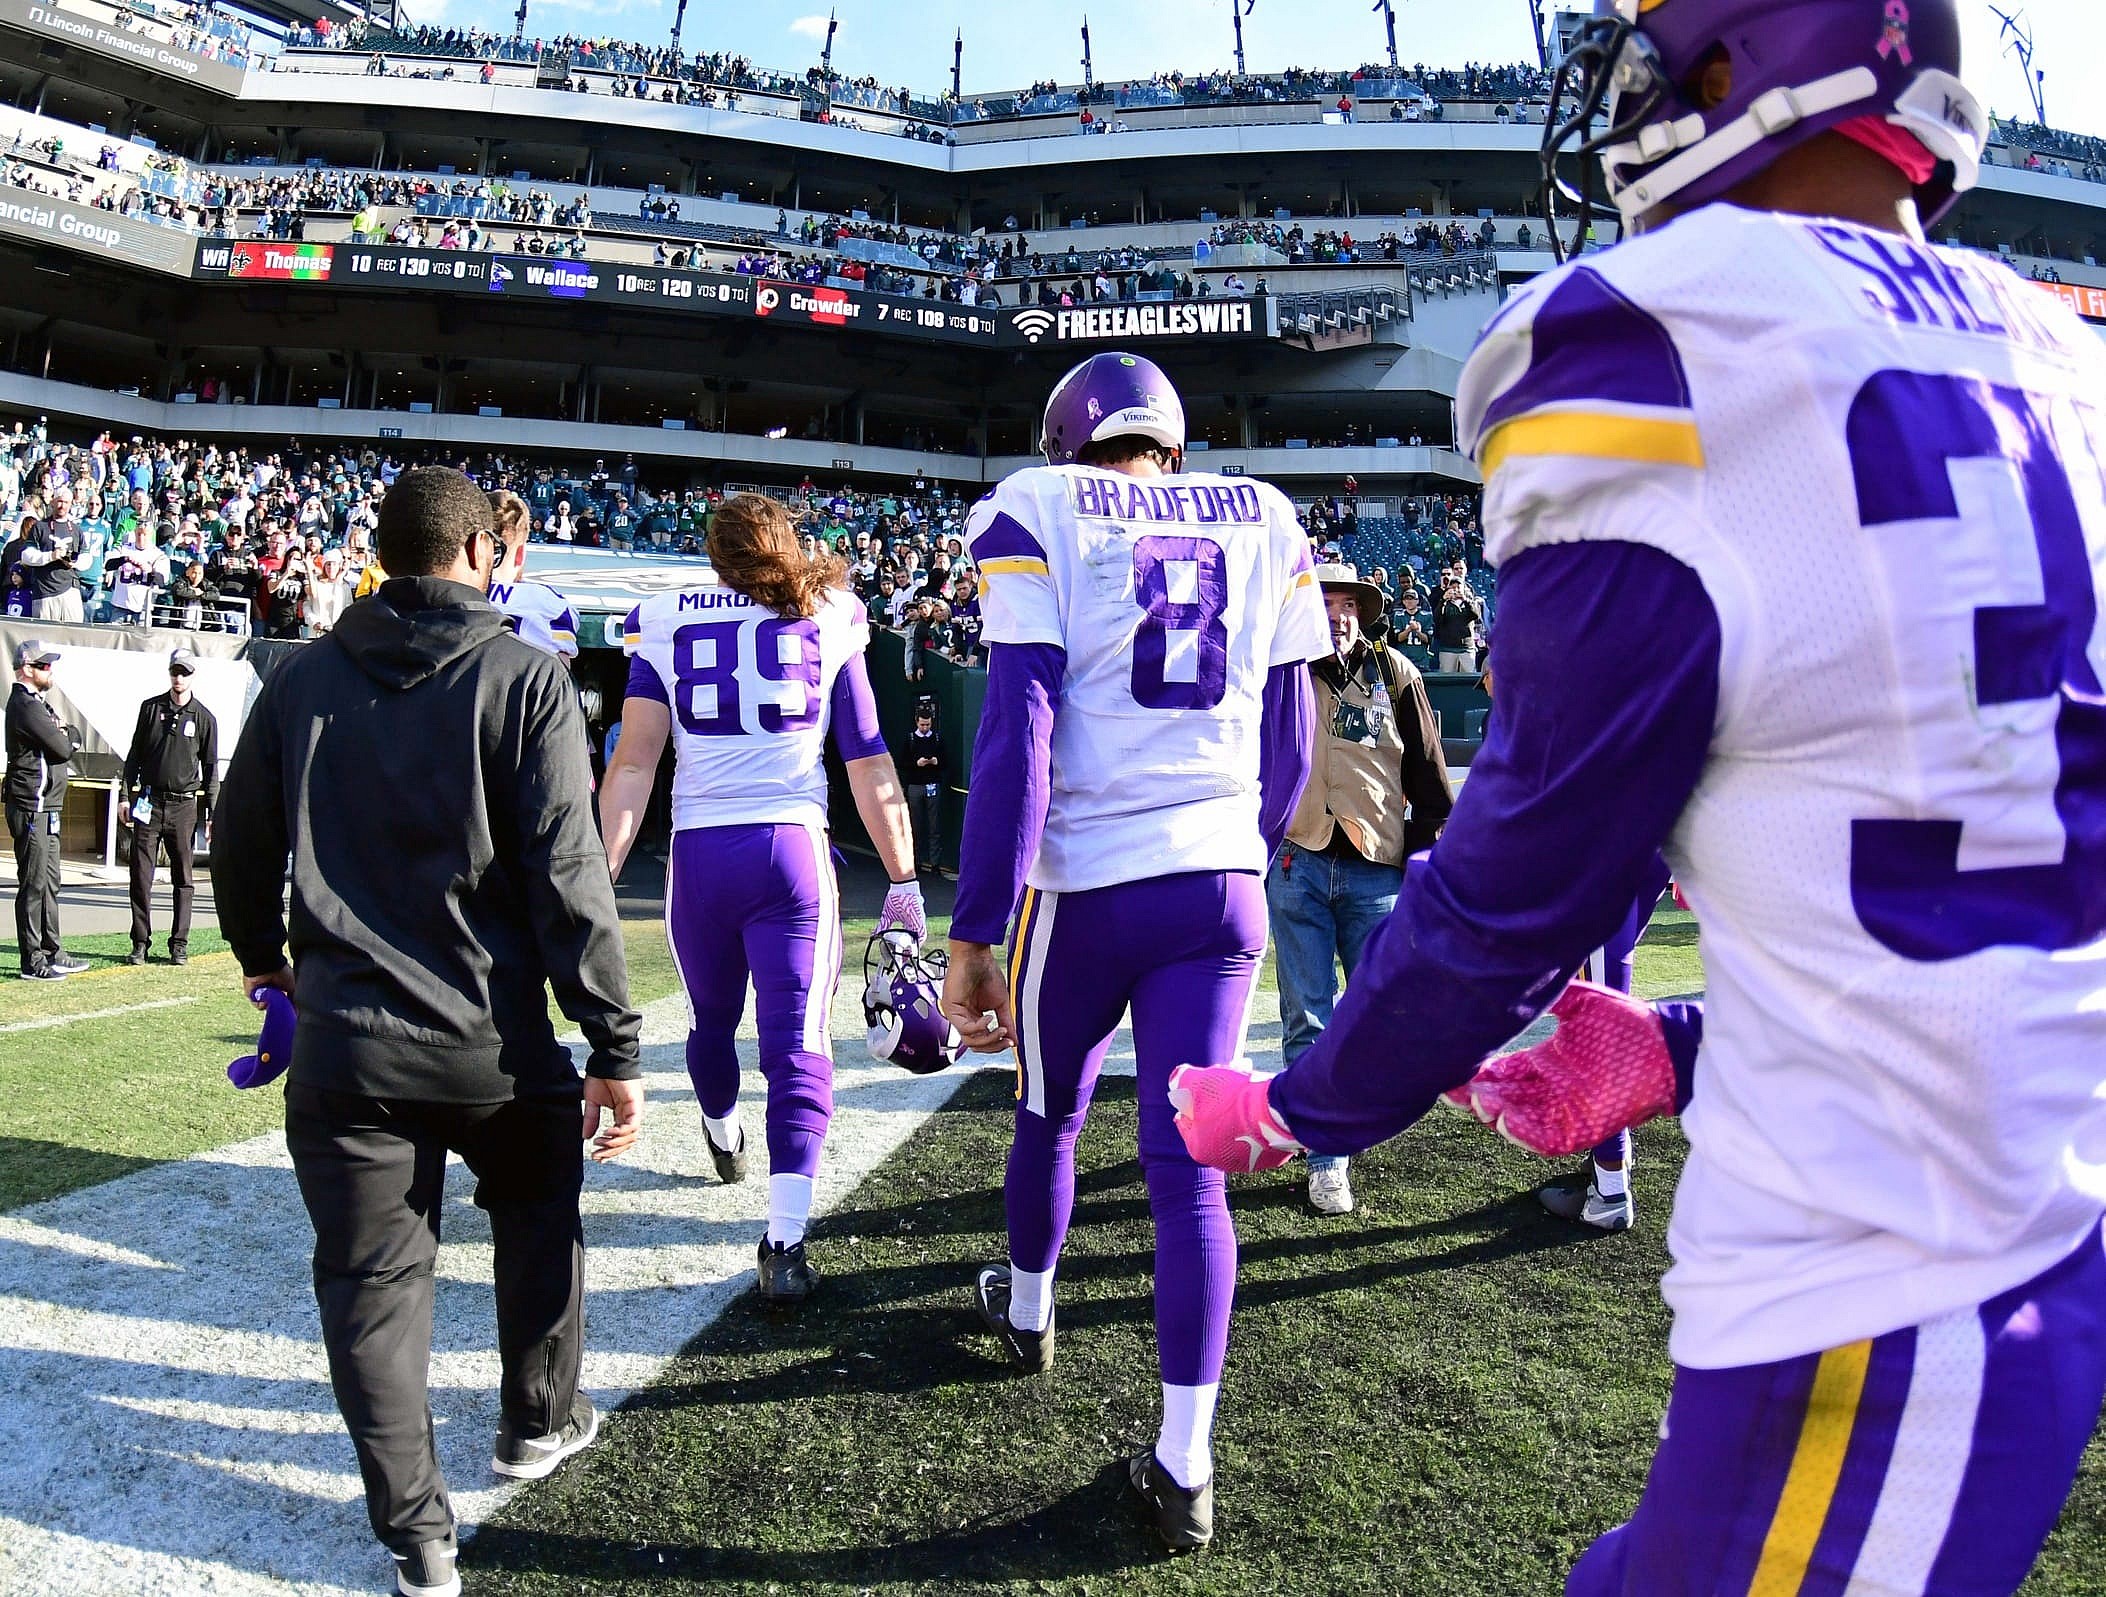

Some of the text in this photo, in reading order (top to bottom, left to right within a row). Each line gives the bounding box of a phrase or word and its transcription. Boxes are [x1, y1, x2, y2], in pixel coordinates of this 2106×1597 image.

[44, 13, 198, 74] Lincoln Financial Group
[59, 213, 121, 248] Group
[201, 248, 229, 267] WR
[264, 250, 332, 271] Thomas
[350, 255, 371, 273] 10
[376, 258, 396, 273] REC
[399, 257, 429, 276] 130
[432, 262, 451, 276] YDS
[526, 265, 599, 290] Wallace
[616, 273, 637, 293] 10
[661, 278, 692, 298] 120
[697, 283, 717, 298] YDS
[790, 292, 861, 319] Crowder
[876, 303, 888, 320] 7
[893, 308, 912, 322] REC
[916, 308, 945, 328] 108
[1057, 302, 1252, 339] FREEEAGLESWIFI
[835, 460, 850, 469] 113
[1074, 477, 1263, 524] BRADFORD
[678, 593, 757, 612] MORG
[1130, 535, 1228, 710] 8
[672, 617, 821, 736] 89
